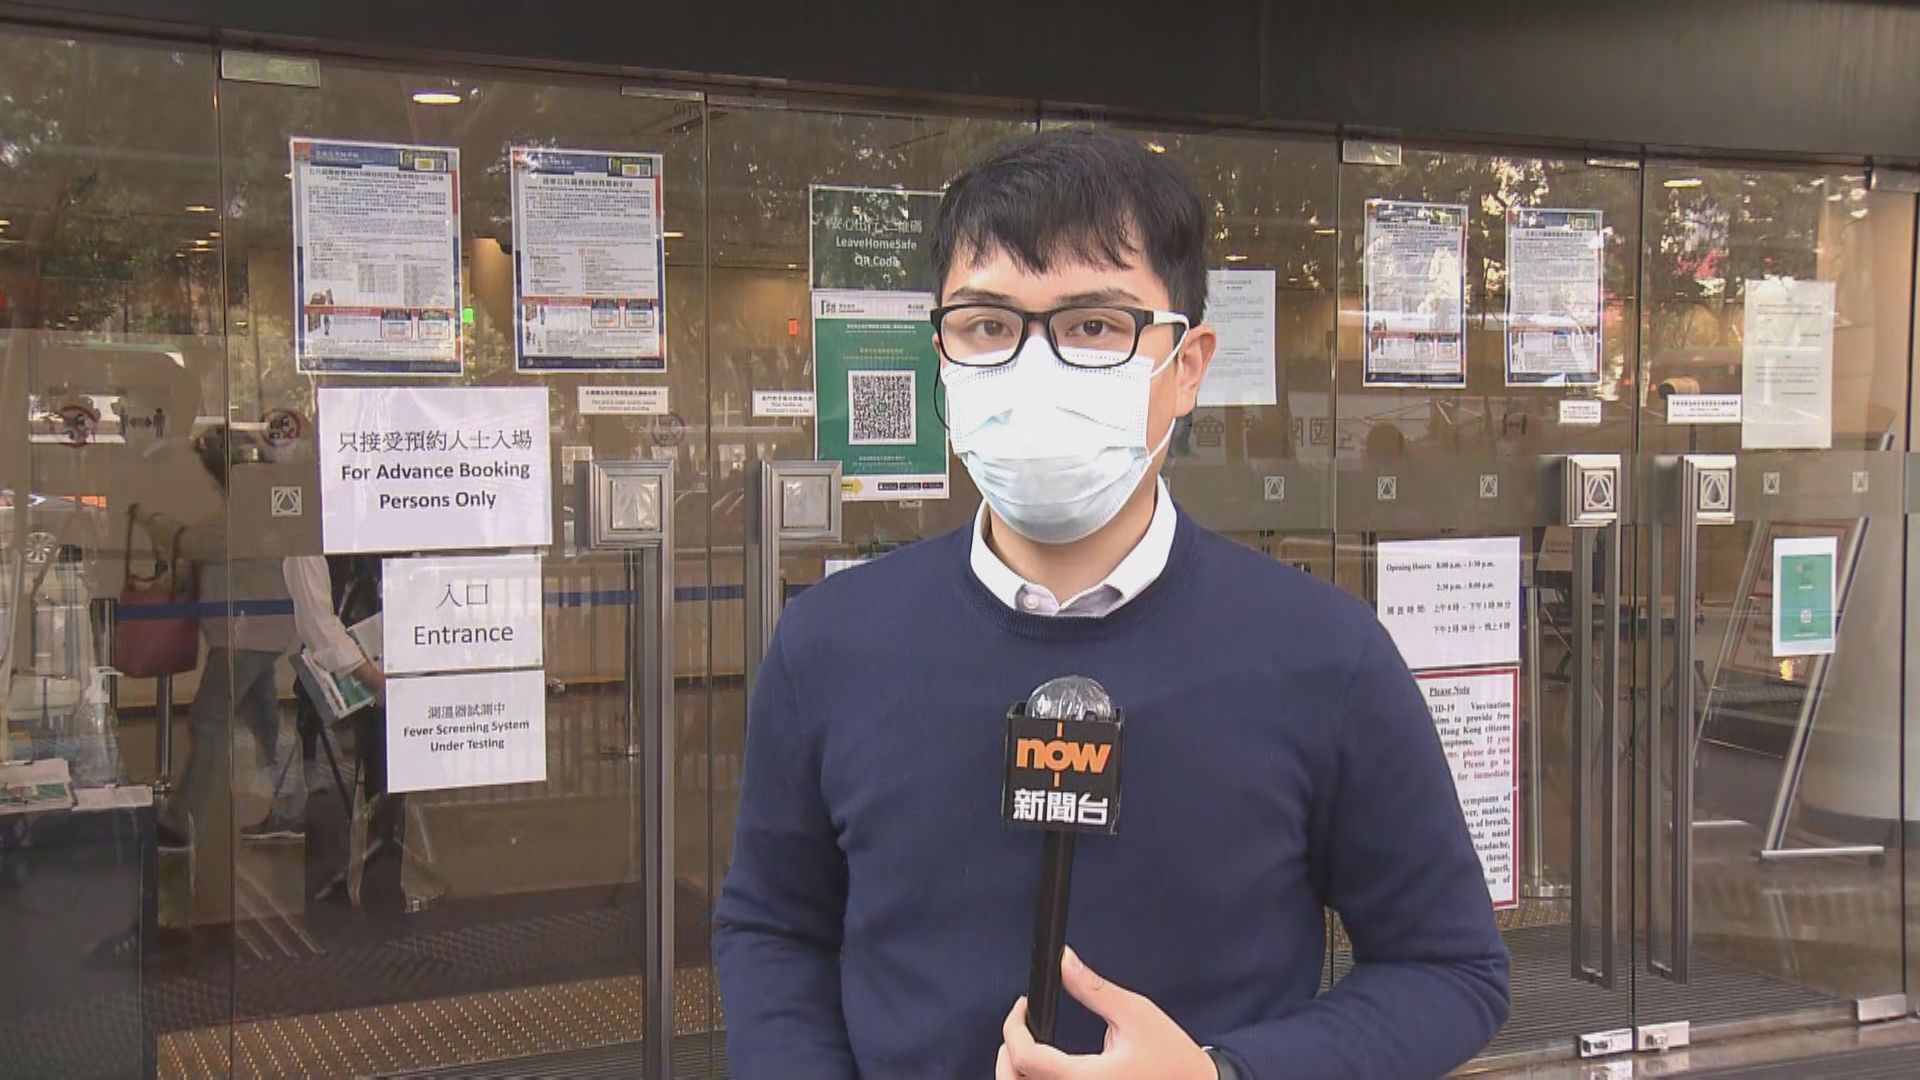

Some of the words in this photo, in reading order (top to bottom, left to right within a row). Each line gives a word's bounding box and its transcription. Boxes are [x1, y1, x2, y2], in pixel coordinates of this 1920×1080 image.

[836, 237, 917, 249] LeaveHomeSafe
[855, 254, 869, 266] QR
[873, 256, 900, 267] Code
[338, 430, 532, 453] 只接受預約人士入場
[342, 466, 371, 480] For
[376, 464, 454, 480] Advance
[460, 462, 530, 479] Booking
[380, 493, 450, 509] Persons
[456, 491, 496, 509] Only
[1386, 564, 1411, 572] Opening
[436, 584, 488, 609] 入口
[414, 626, 513, 645] Entrance
[1429, 687, 1452, 698] Please
[1454, 686, 1470, 696] Note
[1428, 704, 1455, 713] VID-19
[1471, 702, 1511, 711] Vaccination
[1467, 714, 1493, 724] provide
[404, 726, 434, 737] Fever
[436, 722, 489, 735] Screening
[492, 720, 529, 732] System
[1440, 727, 1460, 736] Hong
[1463, 726, 1481, 735] Kong
[1485, 724, 1510, 733] citizens
[430, 741, 464, 752] Under
[467, 738, 504, 749] Testing
[1443, 739, 1474, 748] mptoms.
[1497, 737, 1510, 745] you
[1016, 738, 1112, 773] now
[1463, 749, 1484, 758] please
[1464, 760, 1485, 769] Please
[1490, 760, 1498, 768] go
[1458, 772, 1468, 780] for
[1474, 770, 1510, 779] immediate
[1463, 796, 1499, 806] symptoms
[1503, 793, 1511, 801] of
[1013, 789, 1109, 825] 新聞台
[1482, 807, 1511, 815] malaise,
[1476, 819, 1483, 827] of
[1485, 818, 1511, 826] breath,
[1492, 829, 1510, 838] nasal
[1503, 875, 1511, 883] of
